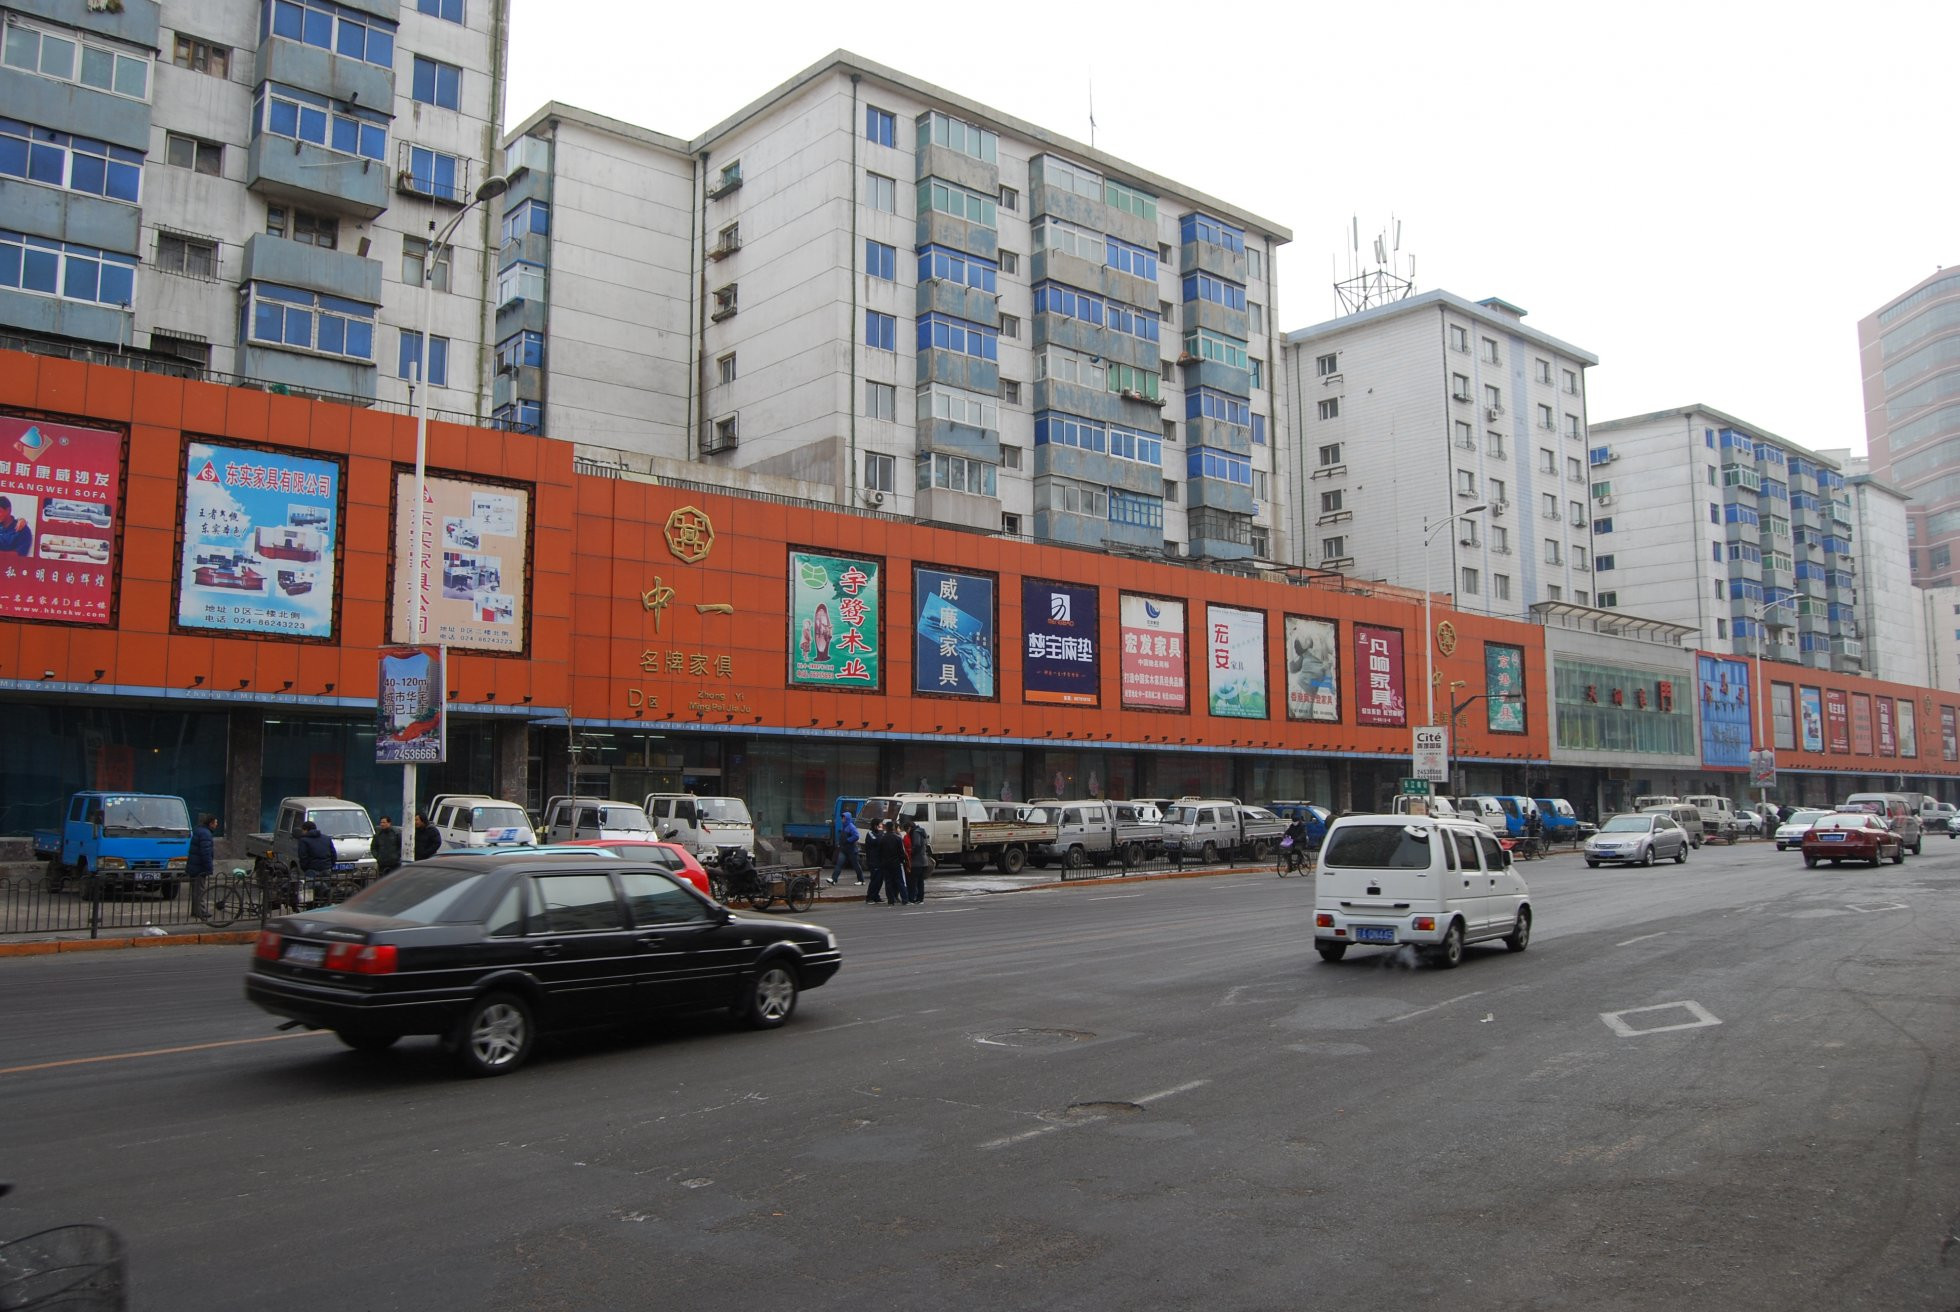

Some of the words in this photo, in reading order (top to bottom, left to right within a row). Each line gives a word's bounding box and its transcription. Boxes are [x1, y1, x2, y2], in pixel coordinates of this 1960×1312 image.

[225, 462, 332, 499] 东实家具有限公司
[75, 488, 107, 500] SOFA
[205, 604, 227, 614] 地址
[233, 606, 301, 620] D区二楼北侧
[640, 575, 734, 635] 中一
[205, 614, 227, 624] 电话
[233, 617, 306, 630] 024-86243223
[836, 565, 873, 680] 宇鹭木业
[938, 578, 959, 687] 威廉家具
[1028, 632, 1093, 663] 梦宝床垫
[1124, 632, 1181, 658] 宏发家具
[640, 649, 733, 679] 名牌家俱
[628, 688, 659, 709] D区
[1417, 732, 1442, 742] Cité
[394, 748, 437, 760] 24536666
